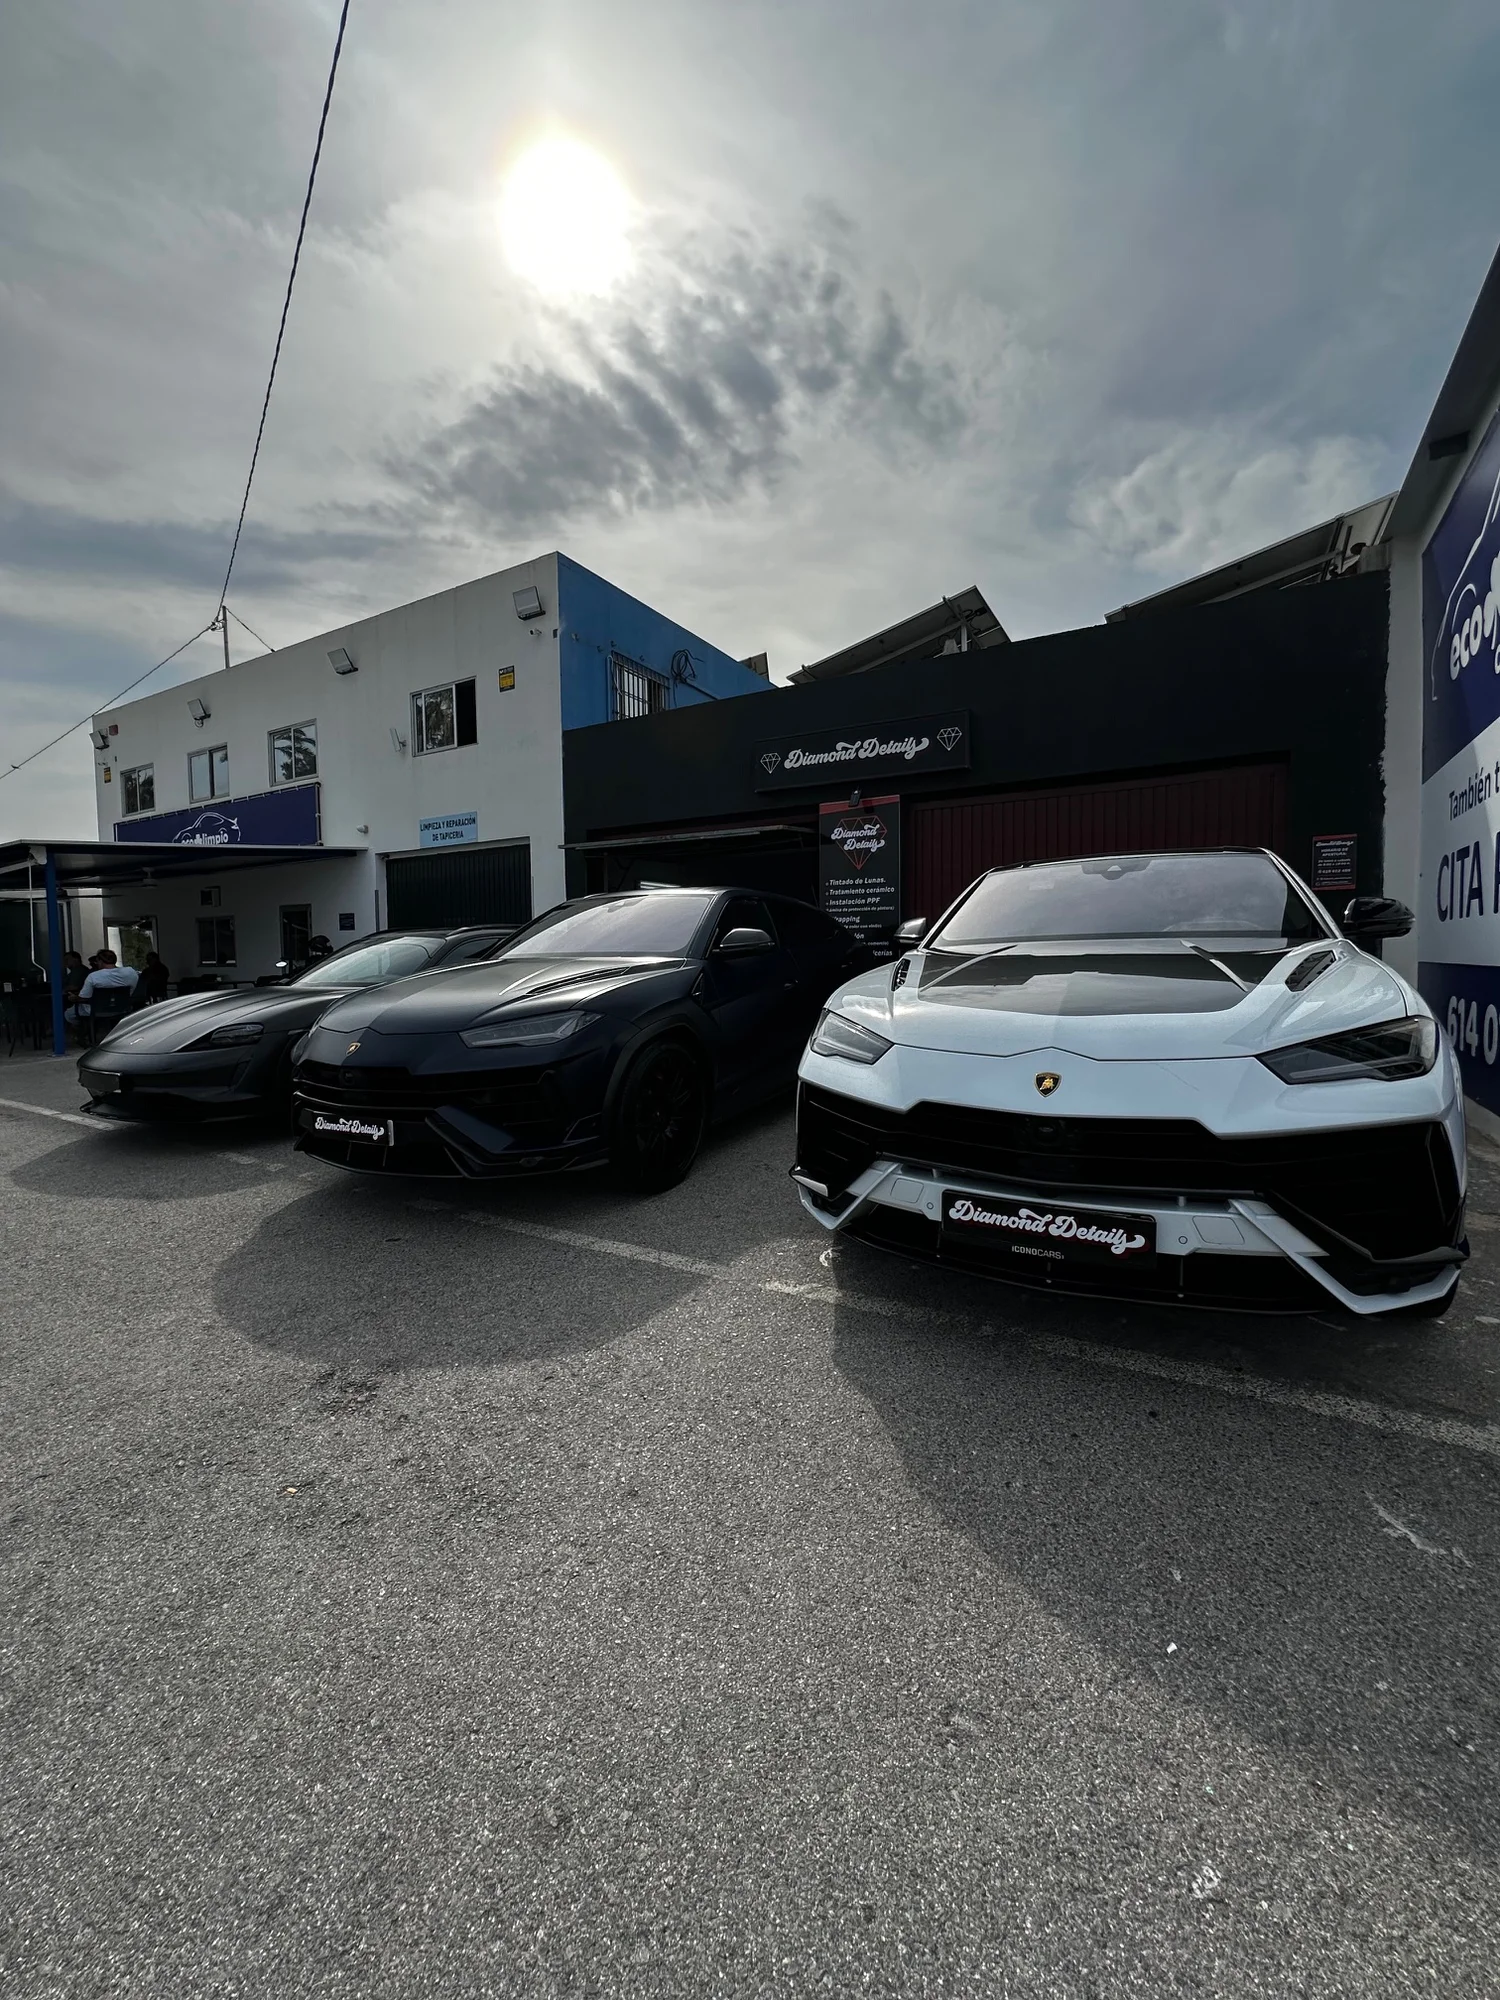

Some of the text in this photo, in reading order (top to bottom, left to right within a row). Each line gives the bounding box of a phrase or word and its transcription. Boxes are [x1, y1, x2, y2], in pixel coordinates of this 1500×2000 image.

[1450, 605, 1482, 681] eco
[784, 737, 930, 769] Diamond Details
[1449, 767, 1491, 821] También
[420, 815, 476, 831] LIMPIEZA Y REPARACIÓN
[831, 823, 880, 840] Diamond
[432, 833, 439, 842] DE
[844, 838, 885, 852] Details
[829, 878, 854, 886] Tintado
[854, 877, 864, 885] de
[1437, 841, 1484, 923] CITA
[829, 886, 895, 896] Tratamiento cerámico
[829, 898, 866, 906] Instalación
[834, 916, 860, 924] rapping
[1447, 995, 1478, 1057] 614
[315, 1116, 385, 1140] Diamond Details
[949, 1200, 1146, 1255] Diamond Details
